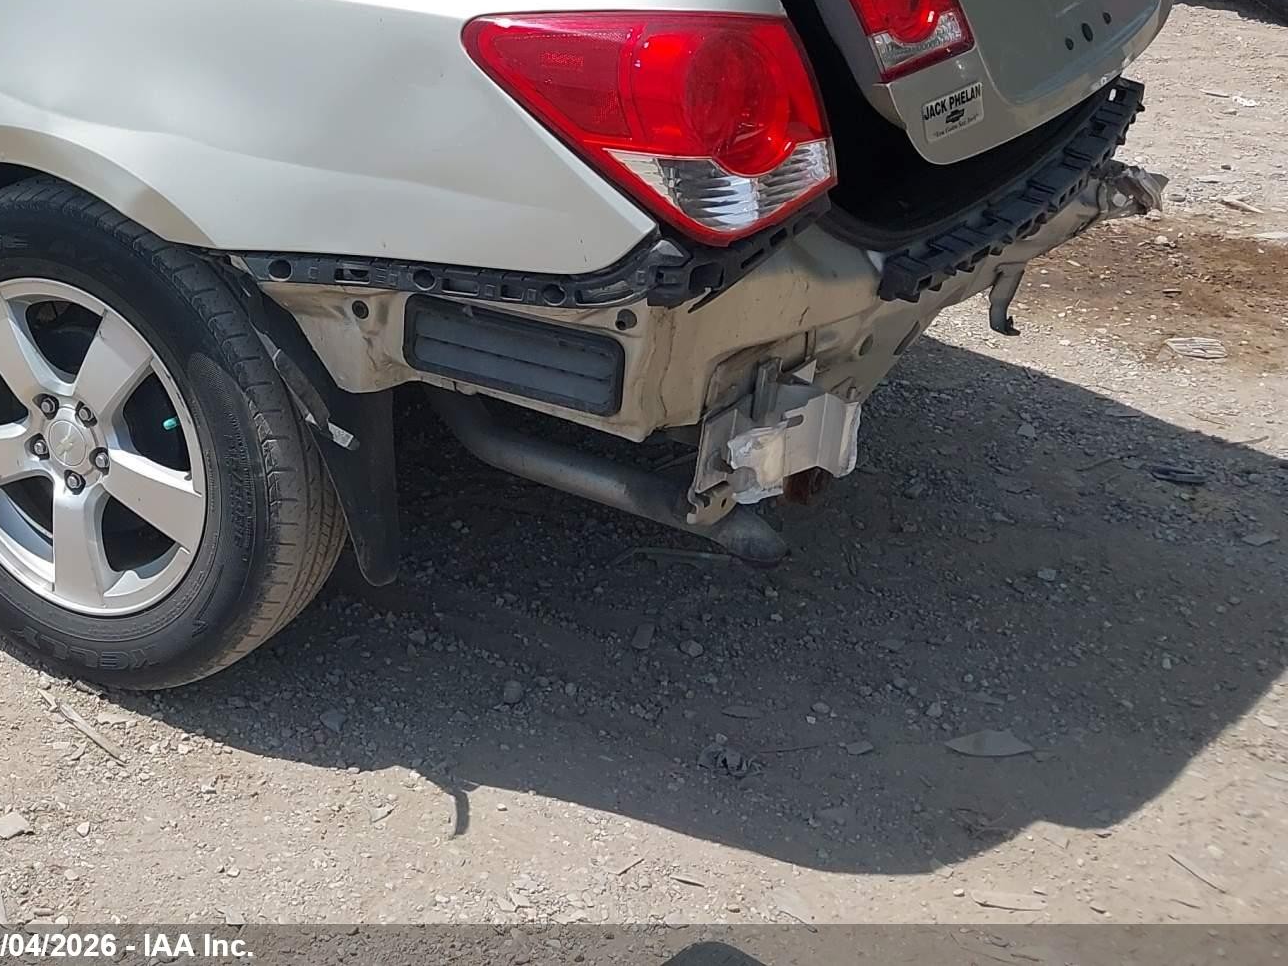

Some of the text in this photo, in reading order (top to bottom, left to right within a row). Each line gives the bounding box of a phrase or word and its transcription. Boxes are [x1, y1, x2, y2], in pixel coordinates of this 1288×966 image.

[923, 98, 948, 121] JACK
[948, 83, 981, 111] PHELAN
[10, 626, 161, 672] KELLY
